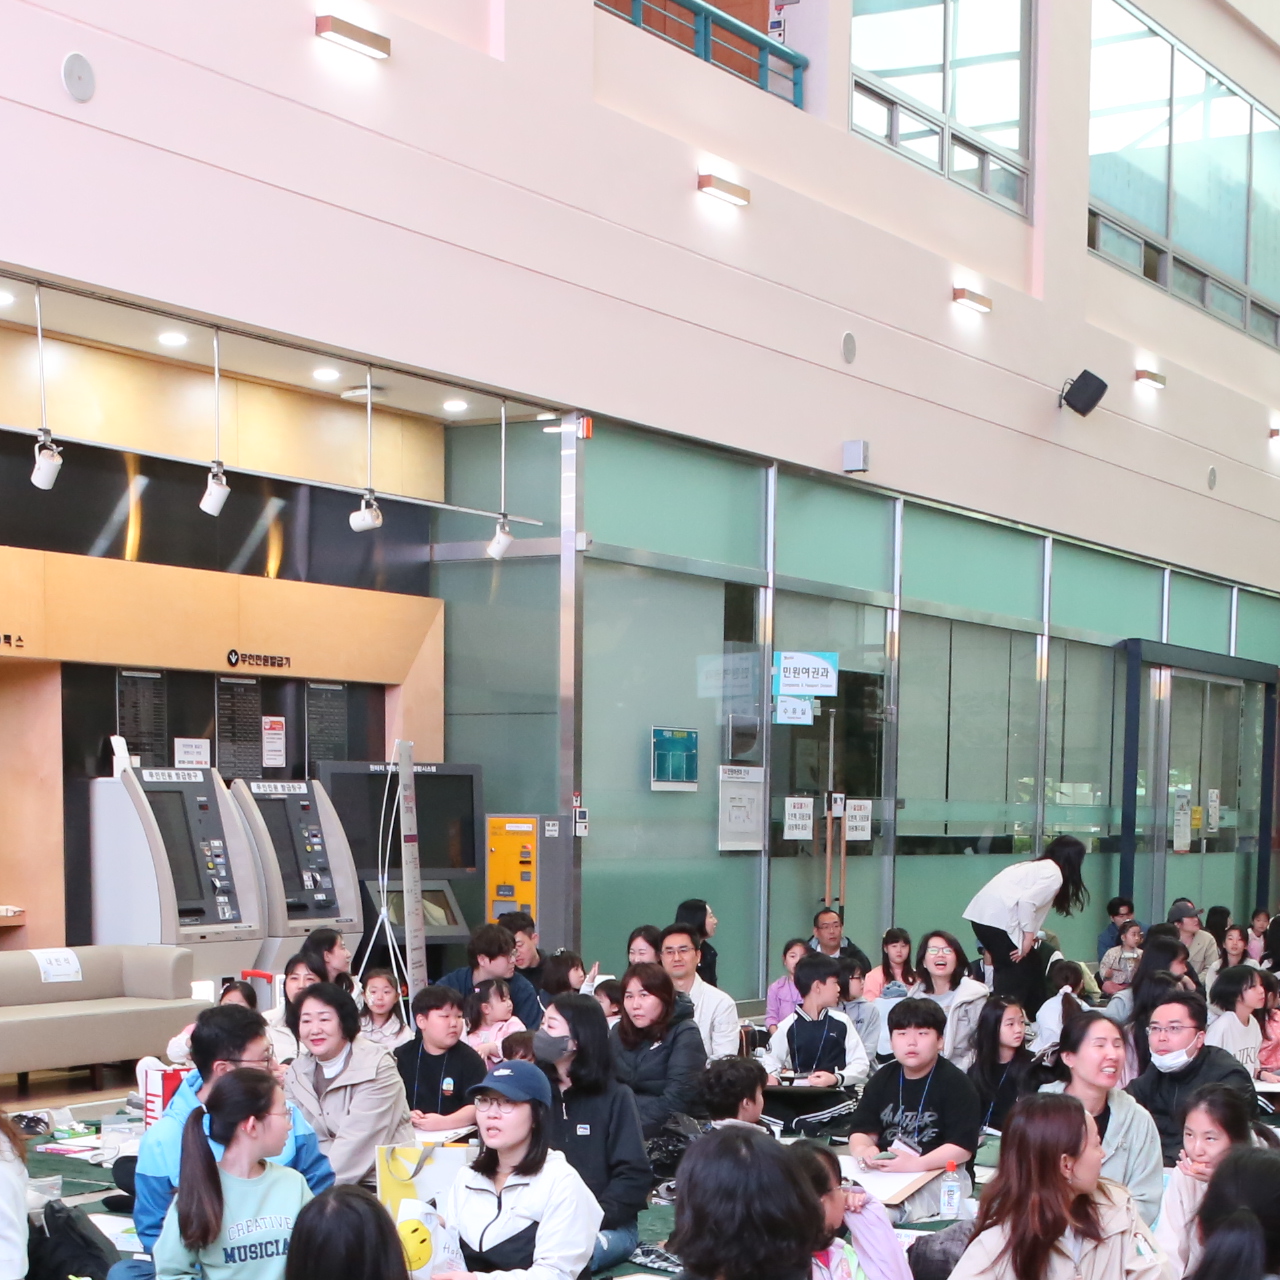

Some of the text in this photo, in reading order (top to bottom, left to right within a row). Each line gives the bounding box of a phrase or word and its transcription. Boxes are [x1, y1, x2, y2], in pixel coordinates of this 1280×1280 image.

[240, 653, 291, 668] 무인민원발급기
[783, 666, 830, 679] 민원여권과
[148, 771, 173, 780] 무인민원
[228, 1216, 294, 1241] CREATIVE
